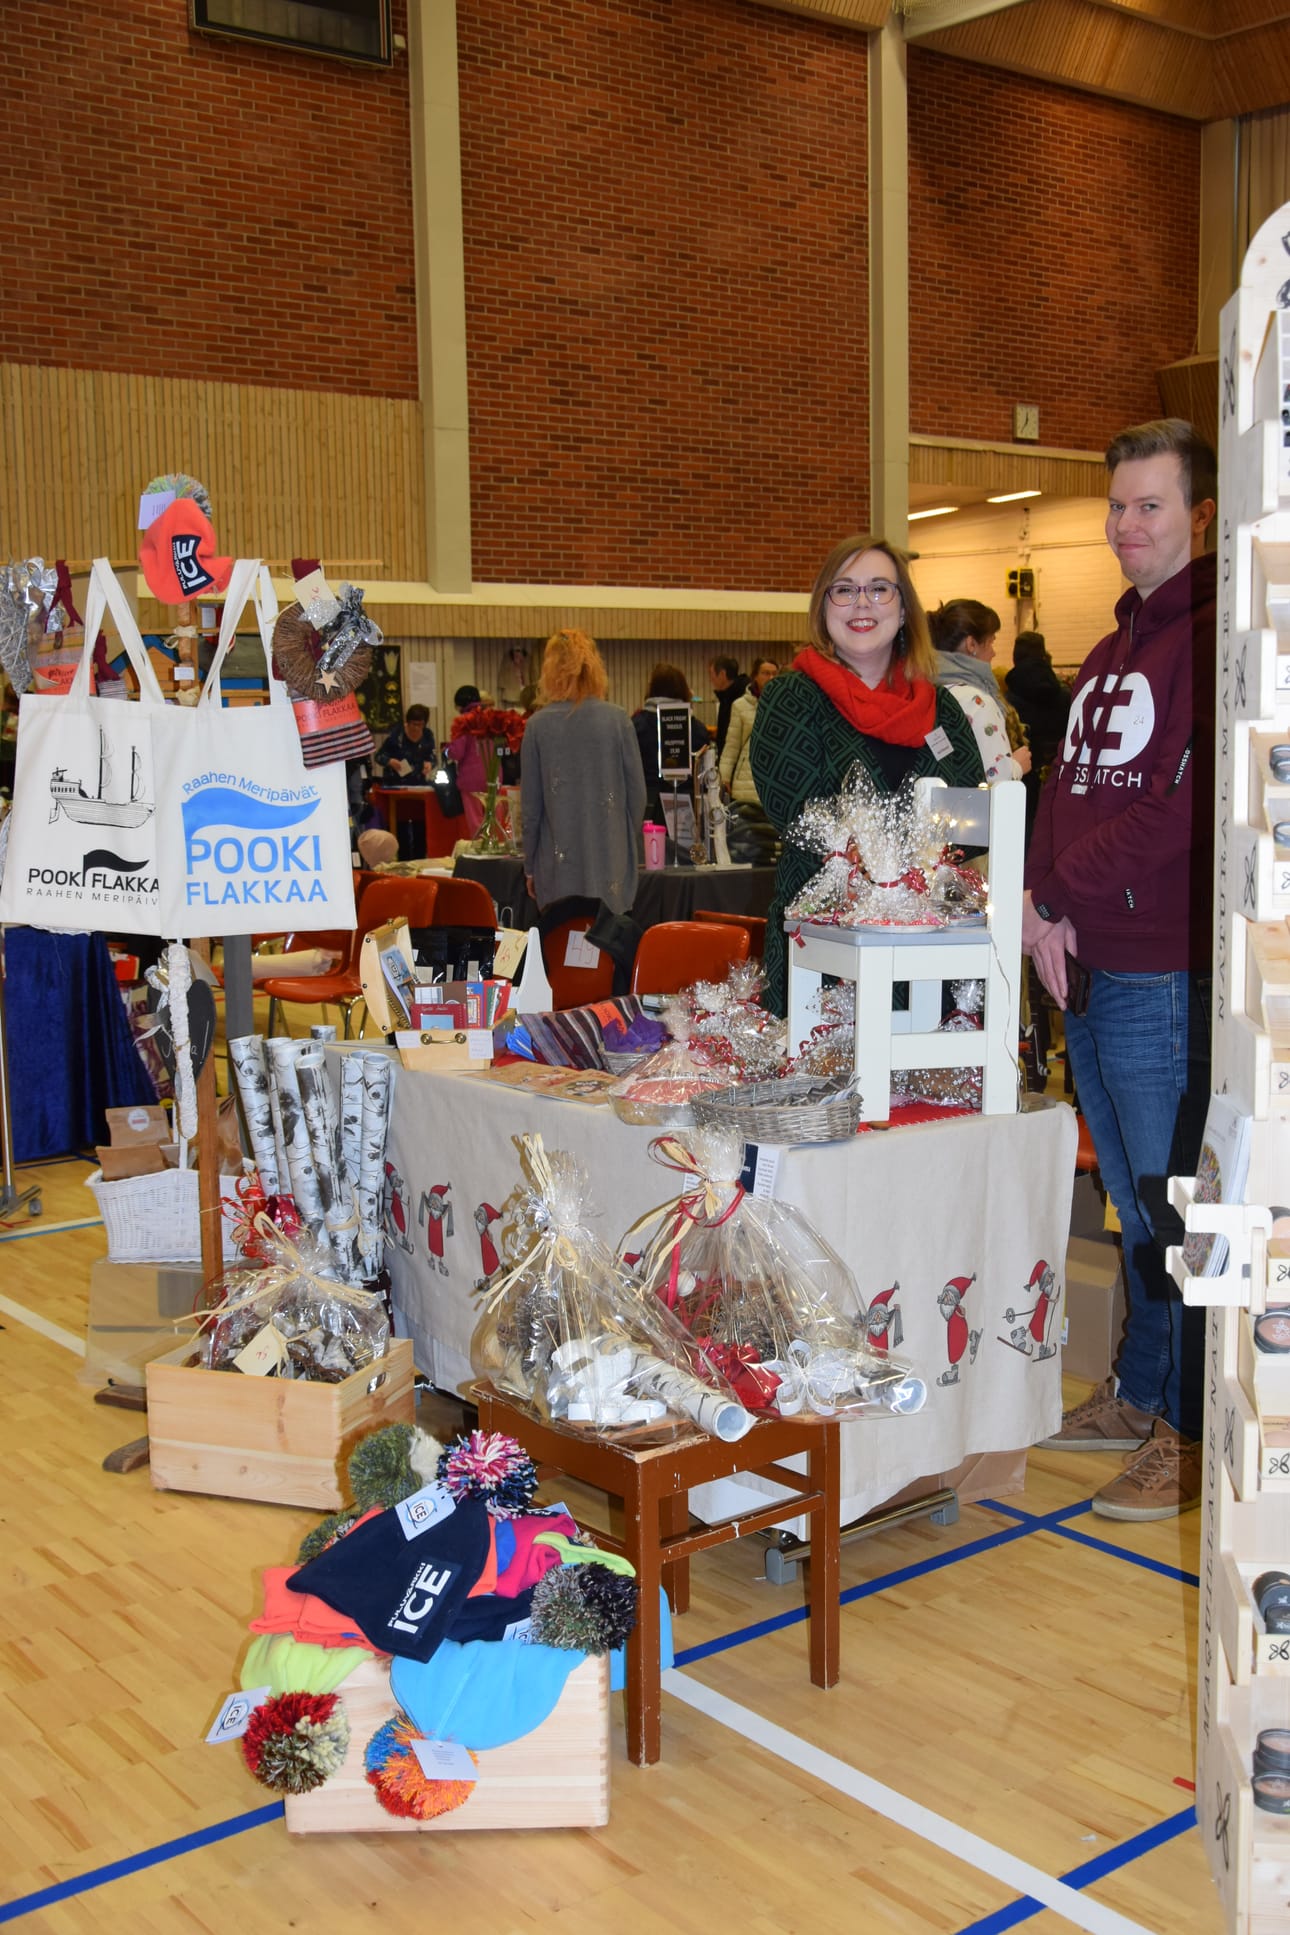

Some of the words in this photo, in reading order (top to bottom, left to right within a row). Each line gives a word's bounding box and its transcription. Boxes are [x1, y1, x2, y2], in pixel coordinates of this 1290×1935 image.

[175, 539, 208, 588] ICE
[1221, 518, 1230, 757] MAKE-UP
[181, 771, 237, 795] Raahen
[238, 777, 319, 802] Meripäivät
[185, 835, 323, 875] POOKI
[26, 887, 83, 900] RAAHEN
[91, 892, 159, 906] MERIPÄIV
[28, 867, 86, 887] POOKI
[91, 873, 160, 893] FLAKKA
[186, 879, 328, 905] FLAKKAA
[1218, 780, 1227, 1021] NATURAL
[413, 1502, 428, 1520] ICE
[393, 1564, 452, 1634] ICE
[1203, 1426, 1215, 1743] MAQUILLAGE
[225, 1705, 242, 1725] ICE
